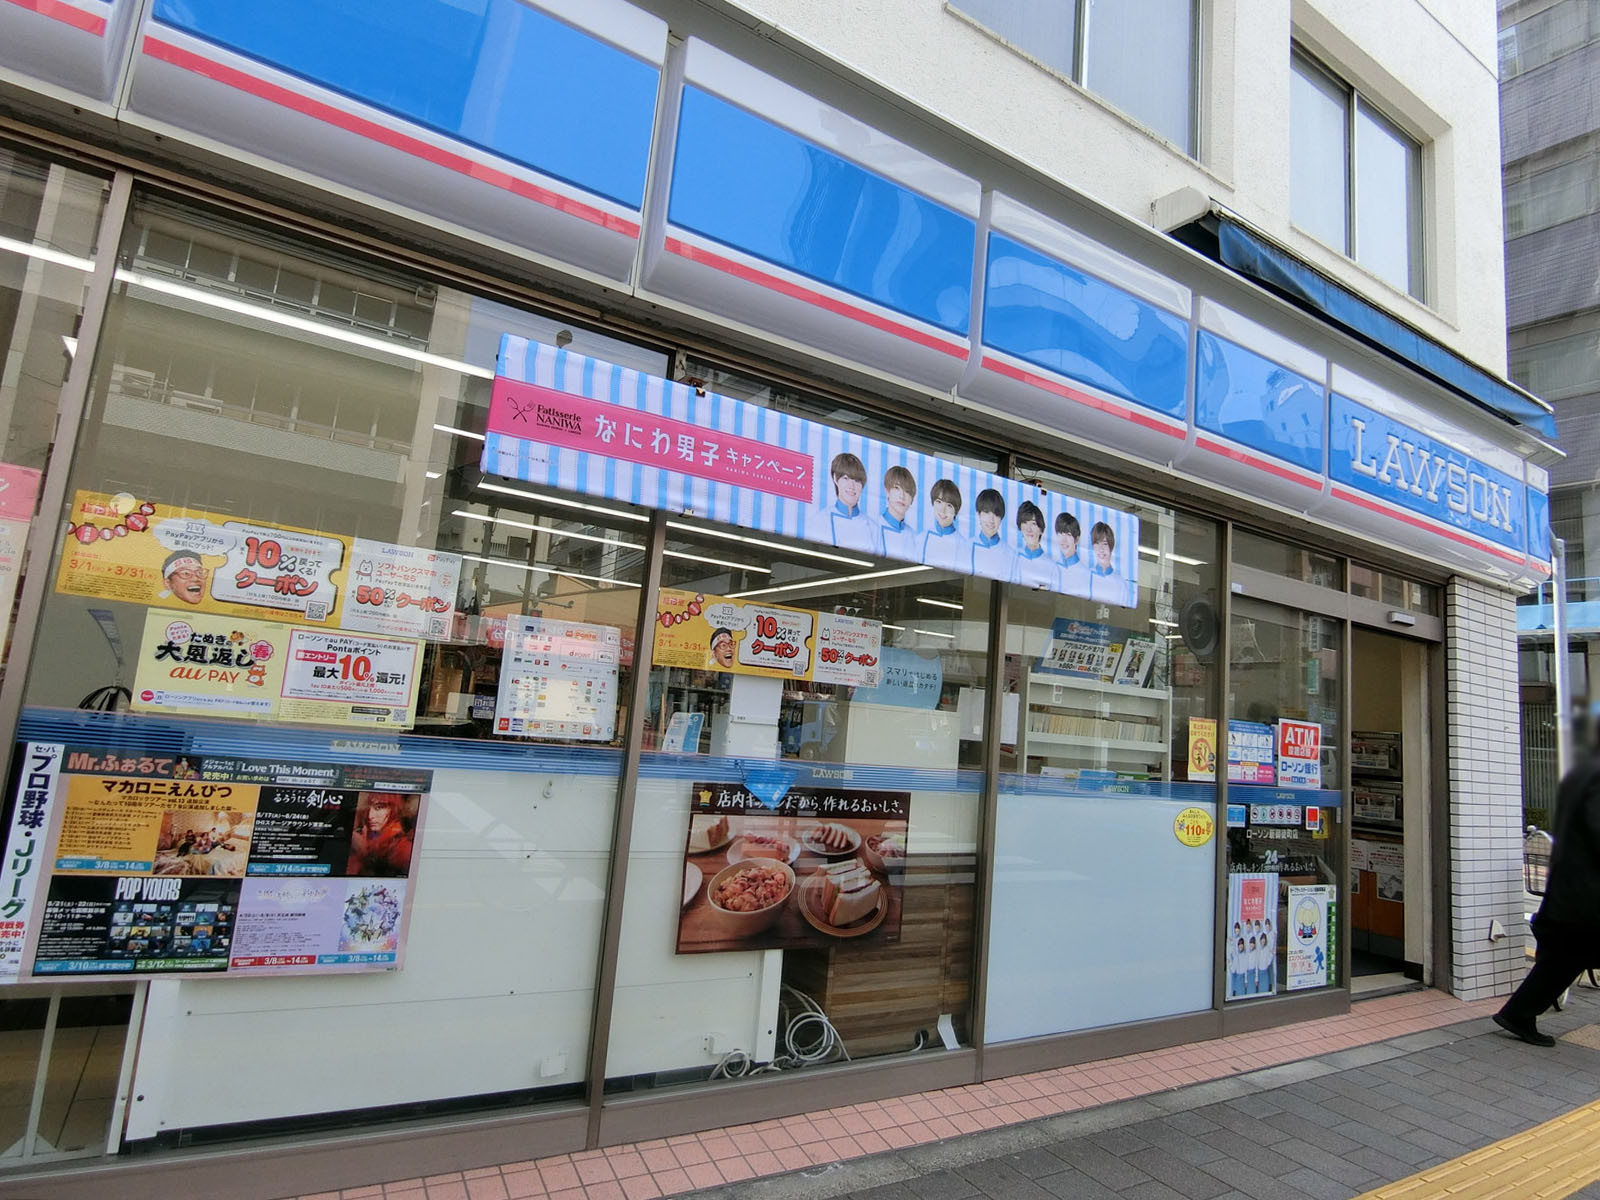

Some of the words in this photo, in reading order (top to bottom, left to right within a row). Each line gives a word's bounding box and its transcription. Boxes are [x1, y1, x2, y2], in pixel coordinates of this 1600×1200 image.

[537, 404, 582, 422] Patisserie
[536, 413, 582, 432] NANIWA
[594, 414, 720, 467] なにわ男子
[726, 447, 807, 480] キャンペーン
[1351, 417, 1513, 534] LAWSON
[165, 531, 225, 545] PayPayアプリから
[245, 536, 298, 573] 10%
[381, 547, 415, 559] LAWSON
[298, 557, 323, 569] 戻って
[298, 567, 318, 577] くる!
[377, 562, 437, 577] ソフトバンクスマホ
[234, 567, 319, 597] クーポン
[376, 570, 417, 582] ユーザーなら
[355, 584, 397, 607] 50%
[395, 592, 452, 614] クーポン
[756, 614, 787, 641] 10%
[190, 632, 234, 647] たぬきの
[751, 638, 800, 659] クーポン
[154, 641, 256, 668] 大恩返し
[252, 644, 270, 659] 春
[326, 643, 382, 656] Pontaポイント
[820, 646, 845, 663] 50%
[844, 651, 878, 667] クーポン
[168, 666, 208, 681] au
[208, 669, 241, 684] PAY
[313, 665, 340, 680] 最大
[338, 654, 375, 682] 10%
[375, 671, 406, 686] 還元!
[886, 678, 937, 690] 新しい返品カタチ!
[1284, 726, 1315, 747] ATM
[67, 752, 174, 776] Mr.ふぉるて
[269, 764, 291, 775] This
[1281, 760, 1318, 775] ローソン銀行
[202, 771, 233, 781] 発売中!
[812, 768, 854, 780] LAWSO
[102, 779, 233, 798] マカロニえんぴつ
[274, 790, 344, 809] るろうに剣心
[0, 754, 58, 919] プロ野球・Jリーグ
[115, 877, 141, 901] POP
[142, 878, 183, 901] YOURS
